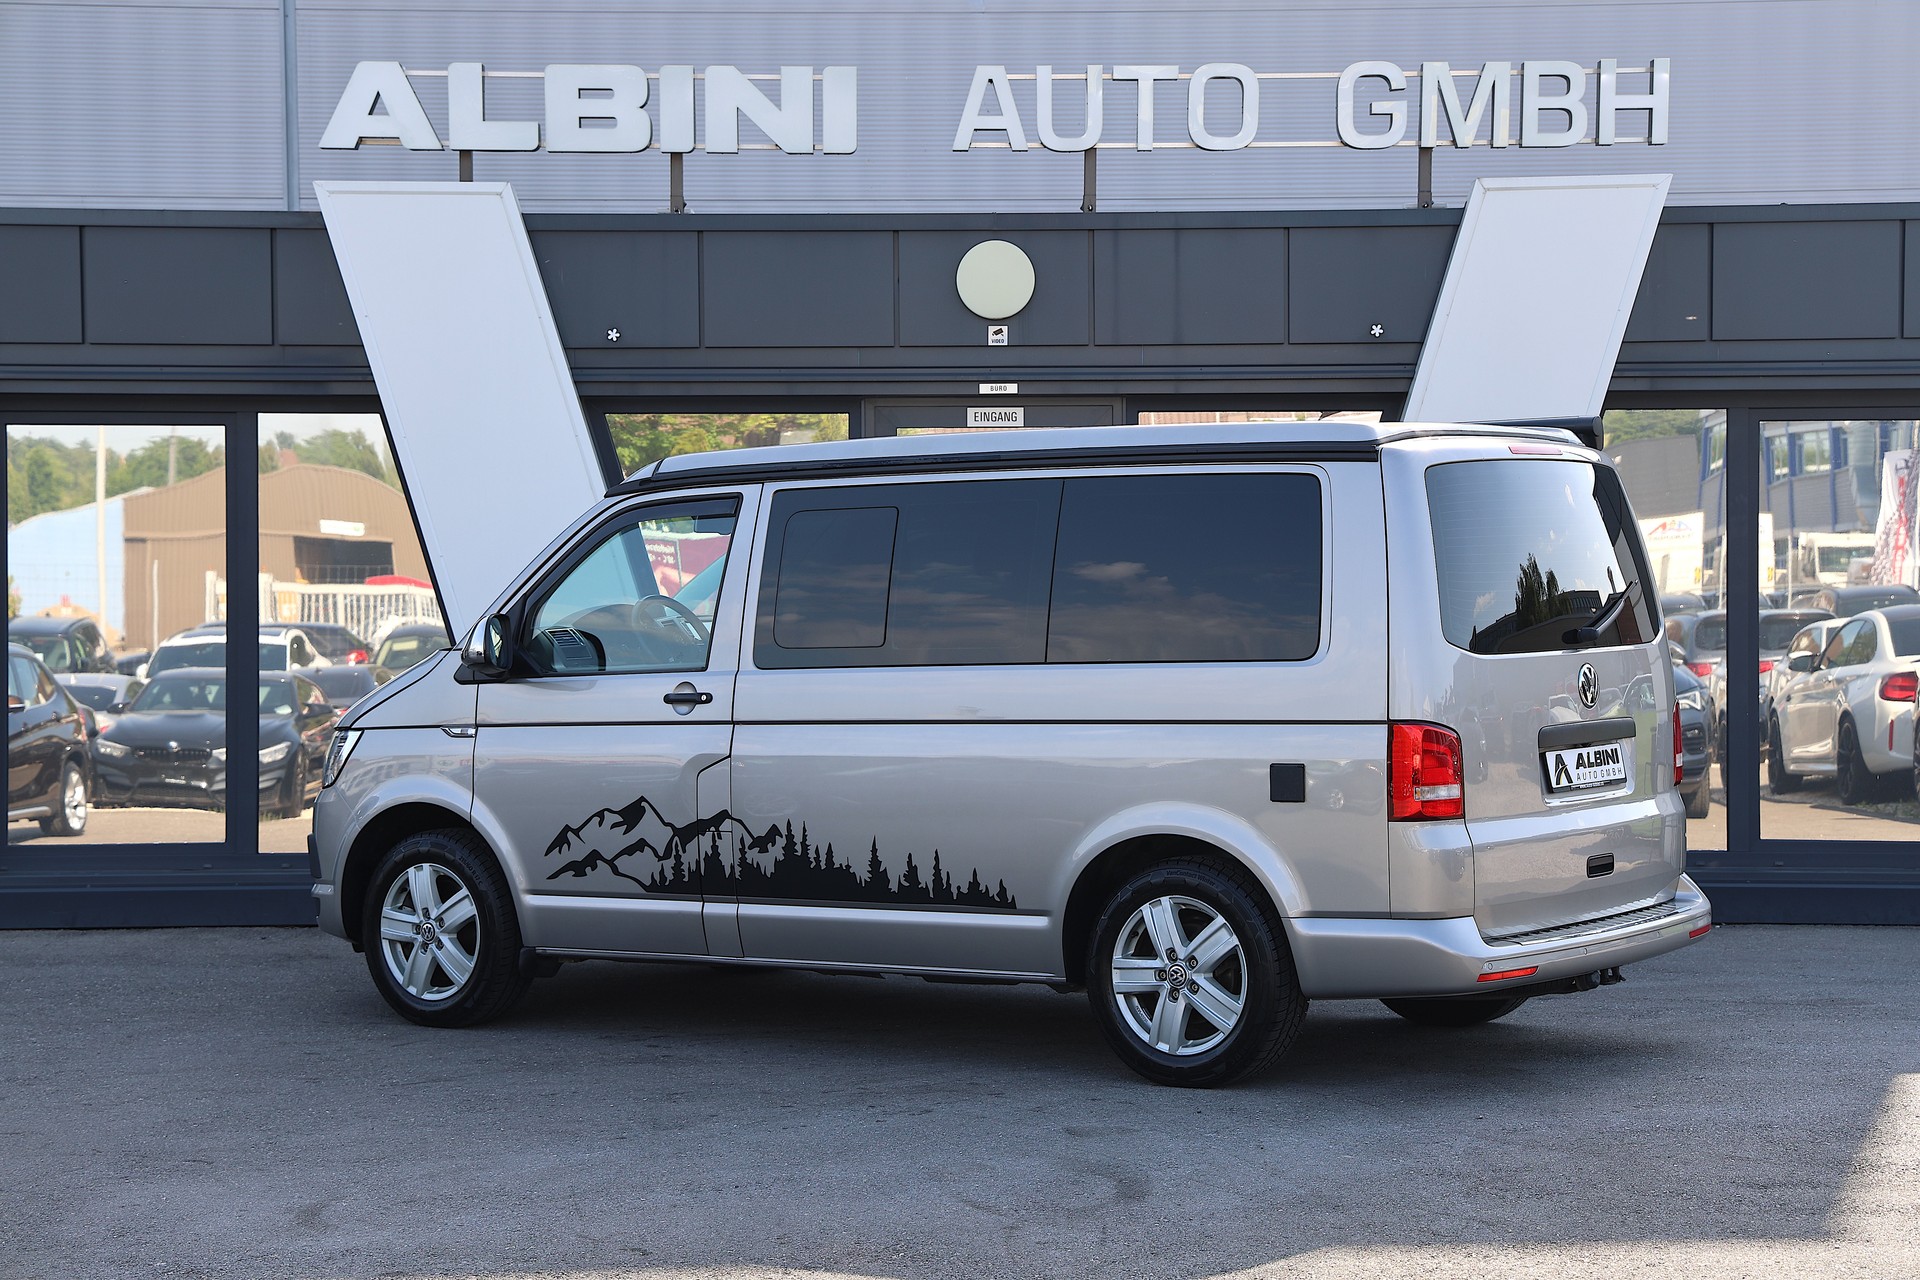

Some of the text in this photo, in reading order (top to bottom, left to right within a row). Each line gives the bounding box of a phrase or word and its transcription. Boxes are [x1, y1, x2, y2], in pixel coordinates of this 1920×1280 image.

[319, 58, 1670, 154] ALBINI AUTO GMBH
[974, 411, 1018, 422] EINGANG
[1576, 748, 1620, 770] ALBINI
[1576, 766, 1623, 781] AUTO GMBH
